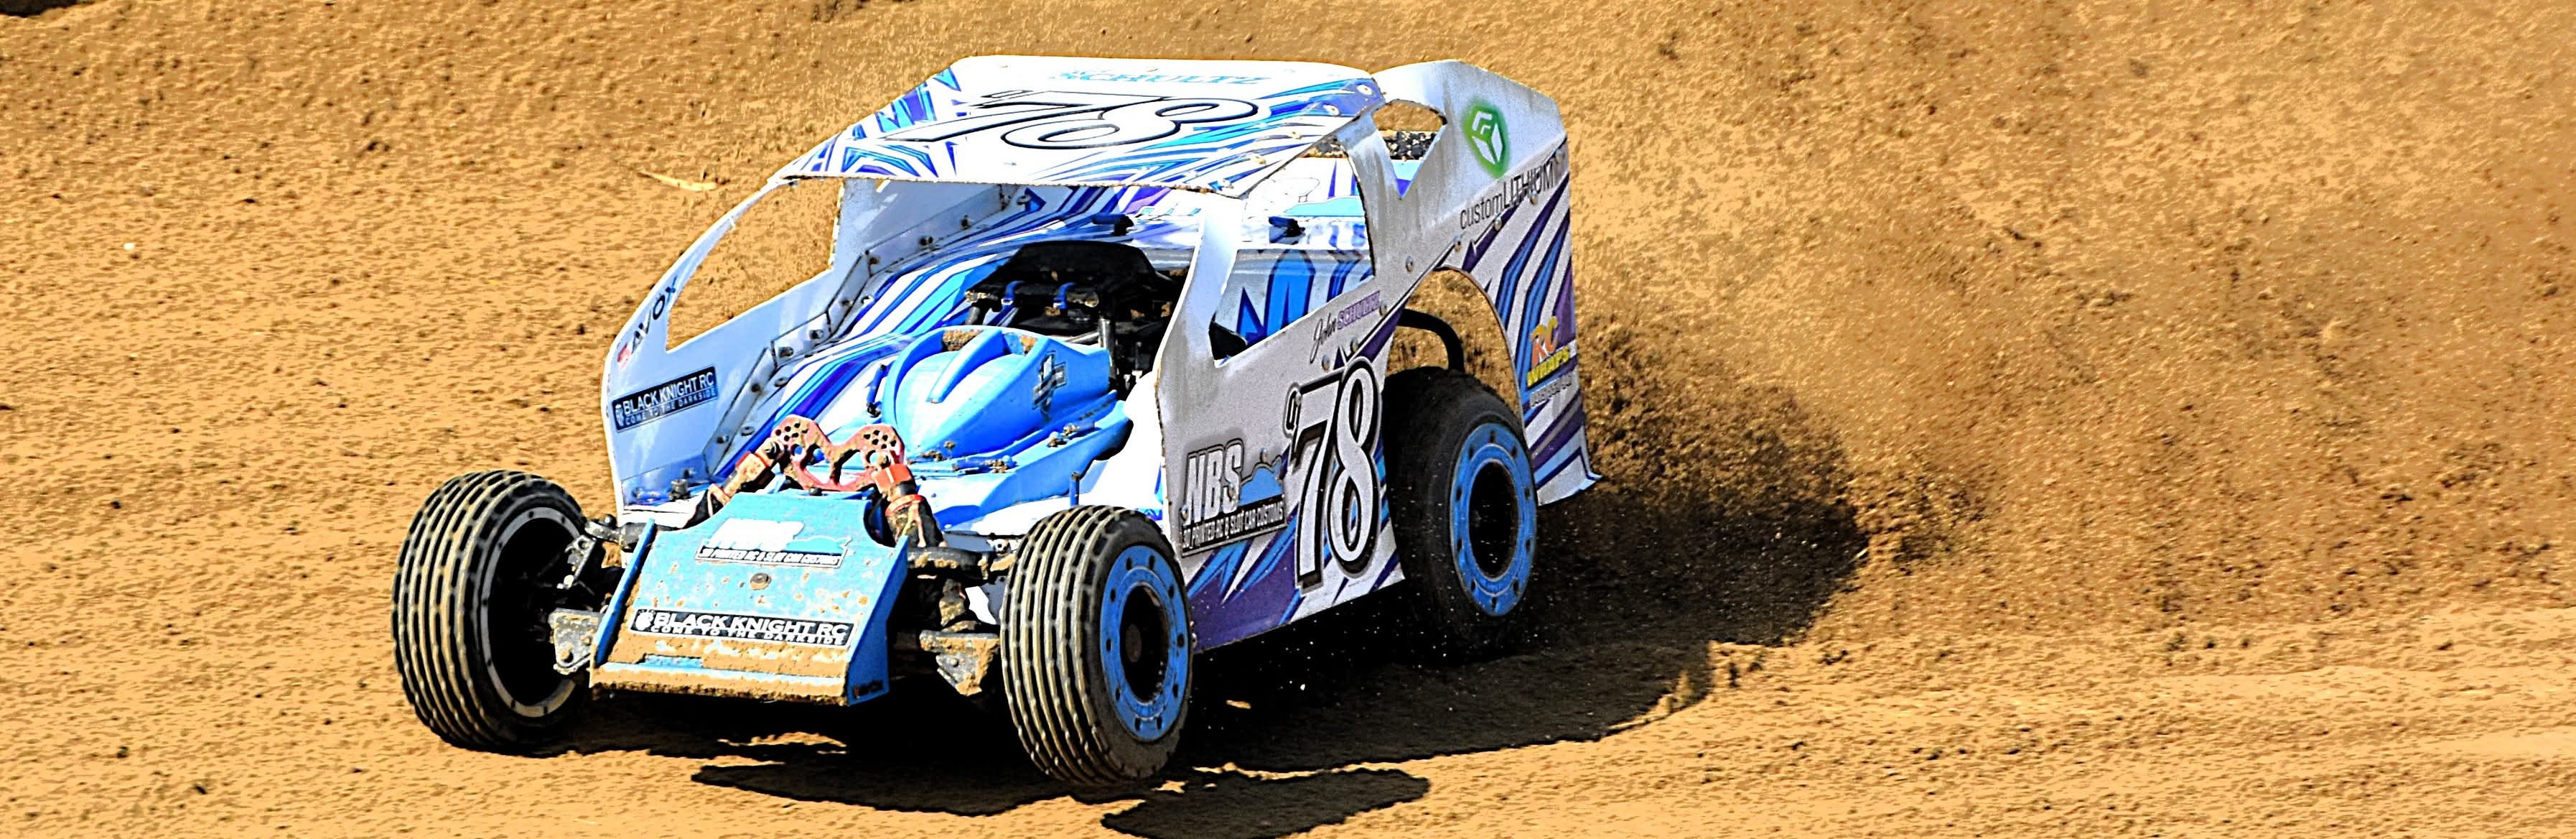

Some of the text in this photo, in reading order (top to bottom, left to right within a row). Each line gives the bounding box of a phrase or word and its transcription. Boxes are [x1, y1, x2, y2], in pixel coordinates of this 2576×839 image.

[1529, 316, 1558, 368] RC
[622, 371, 714, 415] BLACK KNIGHT RC
[625, 412, 647, 426] COME
[648, 407, 660, 417] TO
[678, 388, 717, 407] DARKSIDE
[1183, 439, 1244, 526] NBS
[650, 625, 846, 645] COME TO THE DARKSIDE
[653, 611, 849, 637] BLACK KNIGHT RC
